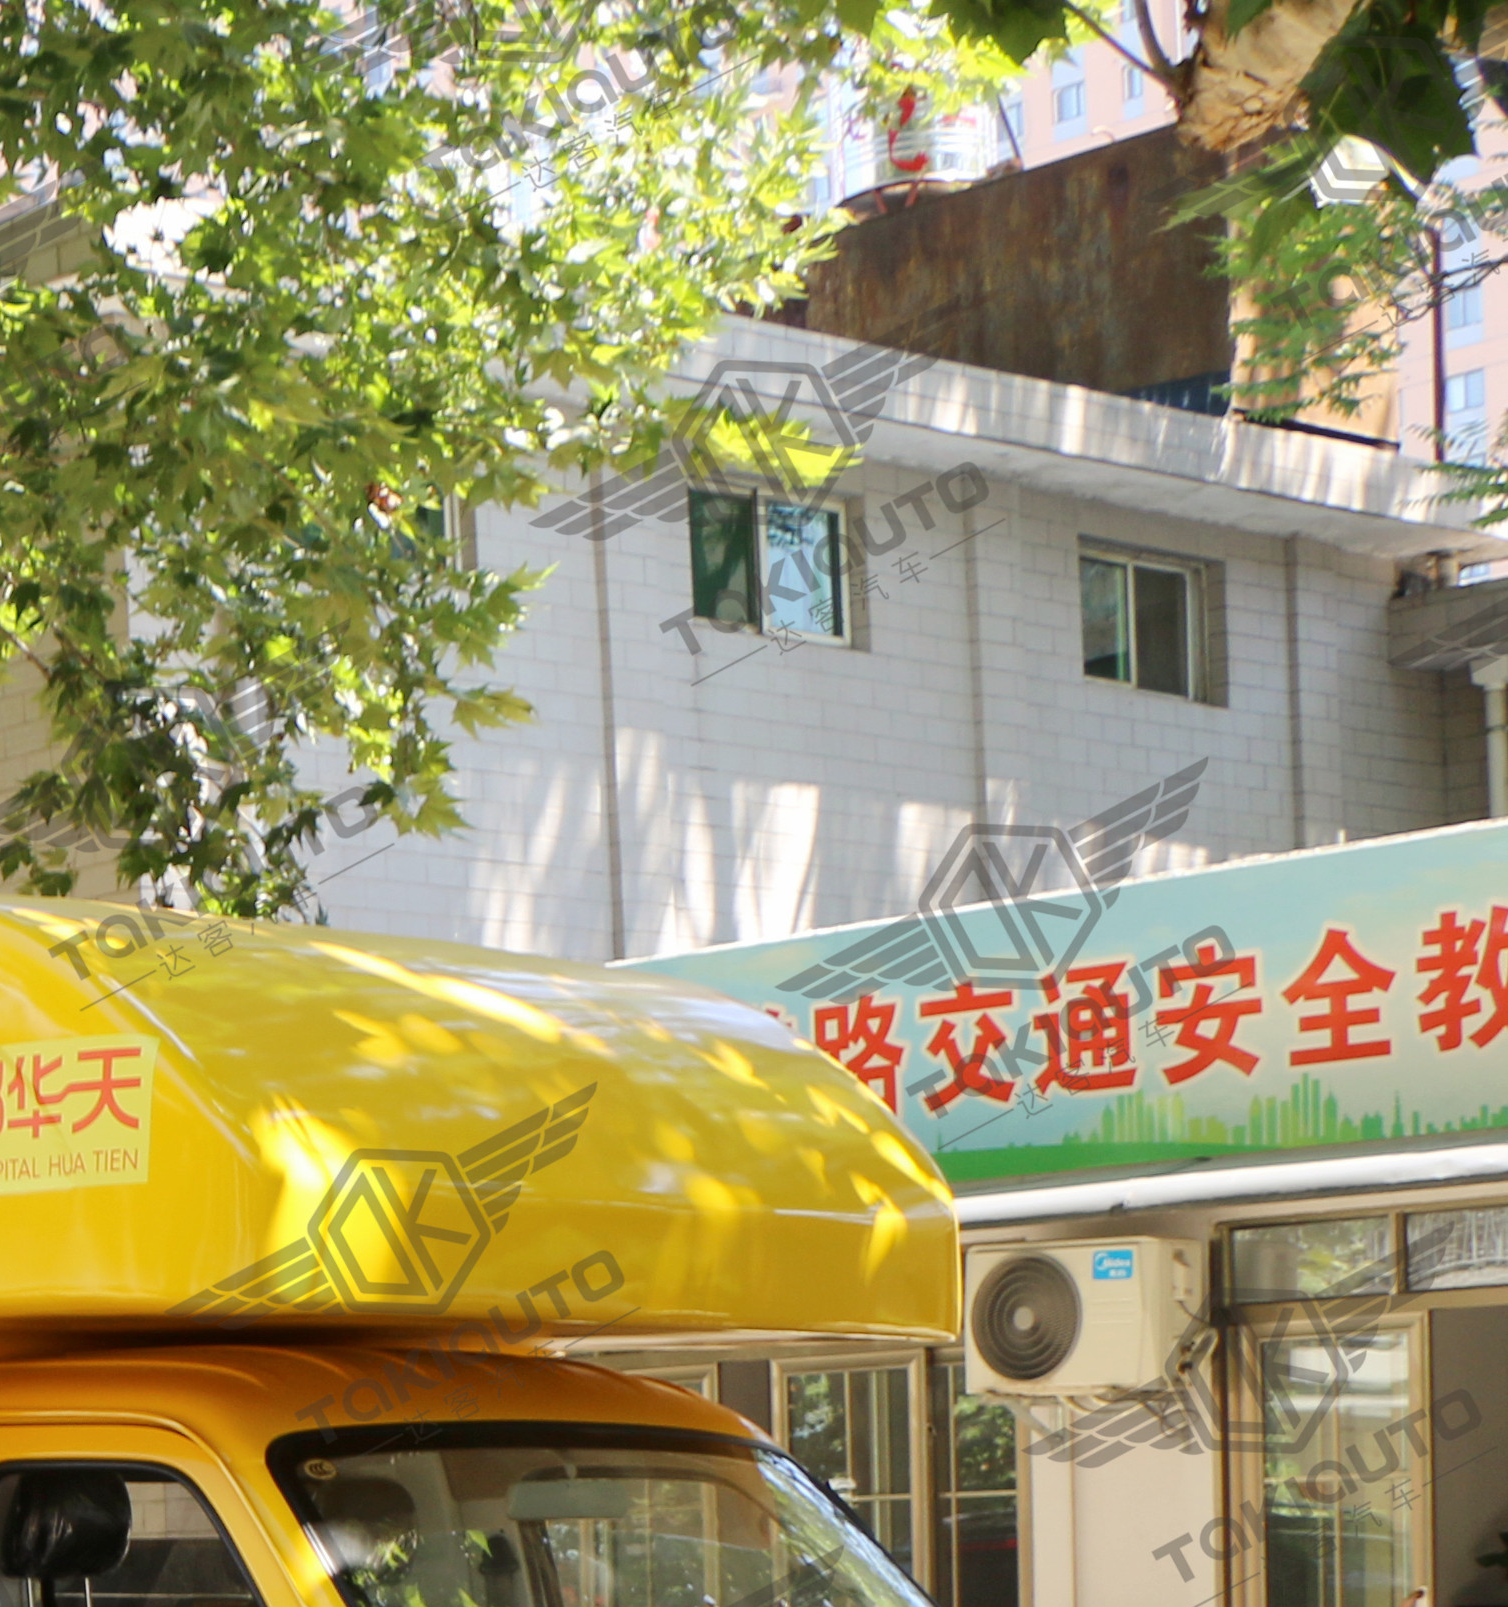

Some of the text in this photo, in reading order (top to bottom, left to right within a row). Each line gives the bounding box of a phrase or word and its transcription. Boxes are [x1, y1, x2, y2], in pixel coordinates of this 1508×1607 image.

[764, 907, 1508, 1116] 路交通安全教
[48, 1151, 87, 1178] HUA
[92, 1148, 139, 1173] TIEN
